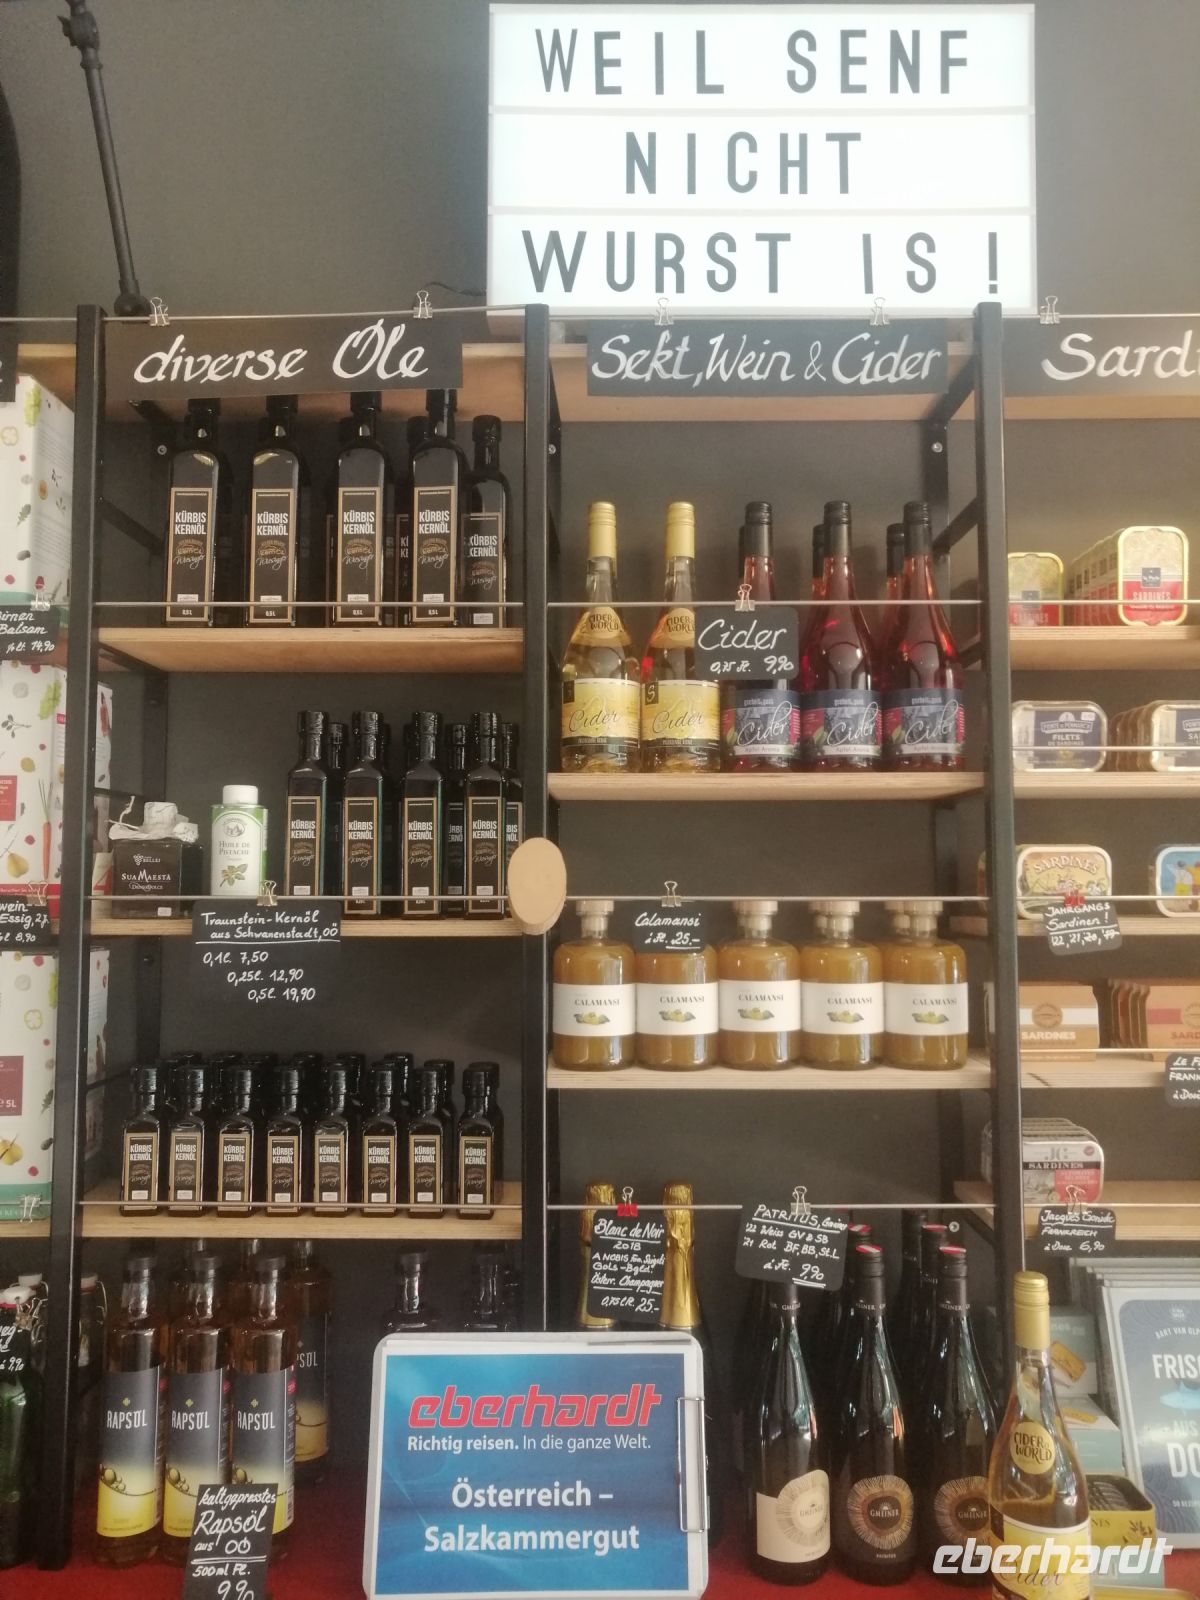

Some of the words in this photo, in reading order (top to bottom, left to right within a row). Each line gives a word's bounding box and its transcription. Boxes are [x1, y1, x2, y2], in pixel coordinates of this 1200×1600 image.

[535, 28, 725, 95] WEIL
[786, 29, 968, 94] SENF
[625, 131, 862, 194] NICHT
[521, 229, 792, 293] WURST
[133, 333, 308, 384] diverse
[802, 339, 827, 381] &
[832, 333, 943, 386] Cider
[1041, 329, 1200, 381] Sard
[175, 510, 207, 524] KÜRBIS
[257, 511, 289, 525] KÜRBIS
[343, 509, 375, 523] KÜRBIS
[419, 508, 450, 522] KÜRBIS
[174, 523, 207, 535] KERNÖL
[256, 524, 289, 536] KERNÖL
[343, 523, 375, 535] KERNÖL
[418, 522, 450, 534] KERNÖL
[697, 618, 788, 651] Cider
[709, 661, 737, 676] 0,75
[763, 655, 795, 676] 9,90
[568, 709, 620, 734] Cider
[652, 711, 705, 735] Cider
[737, 701, 793, 746] Cider
[827, 701, 879, 746] Cider
[905, 699, 959, 745] Cider
[291, 819, 316, 830] KÜRBIS
[348, 820, 374, 831] KÜRBIS
[408, 821, 433, 831] KÜRBIS
[472, 819, 497, 830] KÜRBIS
[290, 829, 316, 839] KERNÖL
[348, 830, 374, 841] KERNÖL
[408, 830, 433, 841] KERNÖL
[472, 829, 498, 839] KERNÖL
[1033, 855, 1100, 874] SARDINES
[634, 911, 702, 927] Calamansi
[1046, 916, 1101, 931] Sardinen
[15, 932, 36, 943] 8,90
[210, 931, 231, 939] aus
[233, 926, 322, 943] Schwanenstadt,
[239, 951, 269, 966] 7,50
[269, 968, 304, 984] 12,90
[282, 987, 316, 1003] 19,90
[574, 997, 620, 1007] CALAMANSI
[659, 995, 705, 1004] CALAMANSI
[738, 993, 784, 1003] CALAMANSI
[827, 996, 873, 1006] CALAMANSI
[912, 998, 958, 1007] CALAMANSI
[1021, 1031, 1077, 1041] SARDINES
[1171, 1031, 1200, 1040] SARD
[594, 1218, 627, 1236] Blanc
[629, 1222, 643, 1237] de
[642, 1221, 665, 1239] Noir
[1041, 1226, 1098, 1237] FRANKREICH
[788, 1229, 806, 1240] GV
[814, 1234, 829, 1244] SB
[613, 1241, 641, 1251] 2018
[799, 1263, 825, 1281] 9,90
[1152, 1353, 1200, 1379] FRIS
[408, 1383, 662, 1429] eberhardt
[407, 1434, 462, 1454] Richtig
[467, 1435, 519, 1450] reisen.
[523, 1435, 536, 1450] In
[540, 1434, 563, 1450] die
[567, 1437, 611, 1453] ganze
[614, 1433, 651, 1449] Welt.
[1013, 1431, 1044, 1447] CIDER
[1014, 1444, 1053, 1465] WORLD
[452, 1477, 592, 1508] Österreich
[870, 1509, 899, 1518] GMEINER
[194, 1505, 268, 1546] Rapsöl
[194, 1542, 214, 1552] aus
[424, 1524, 639, 1556] Salzkammergut
